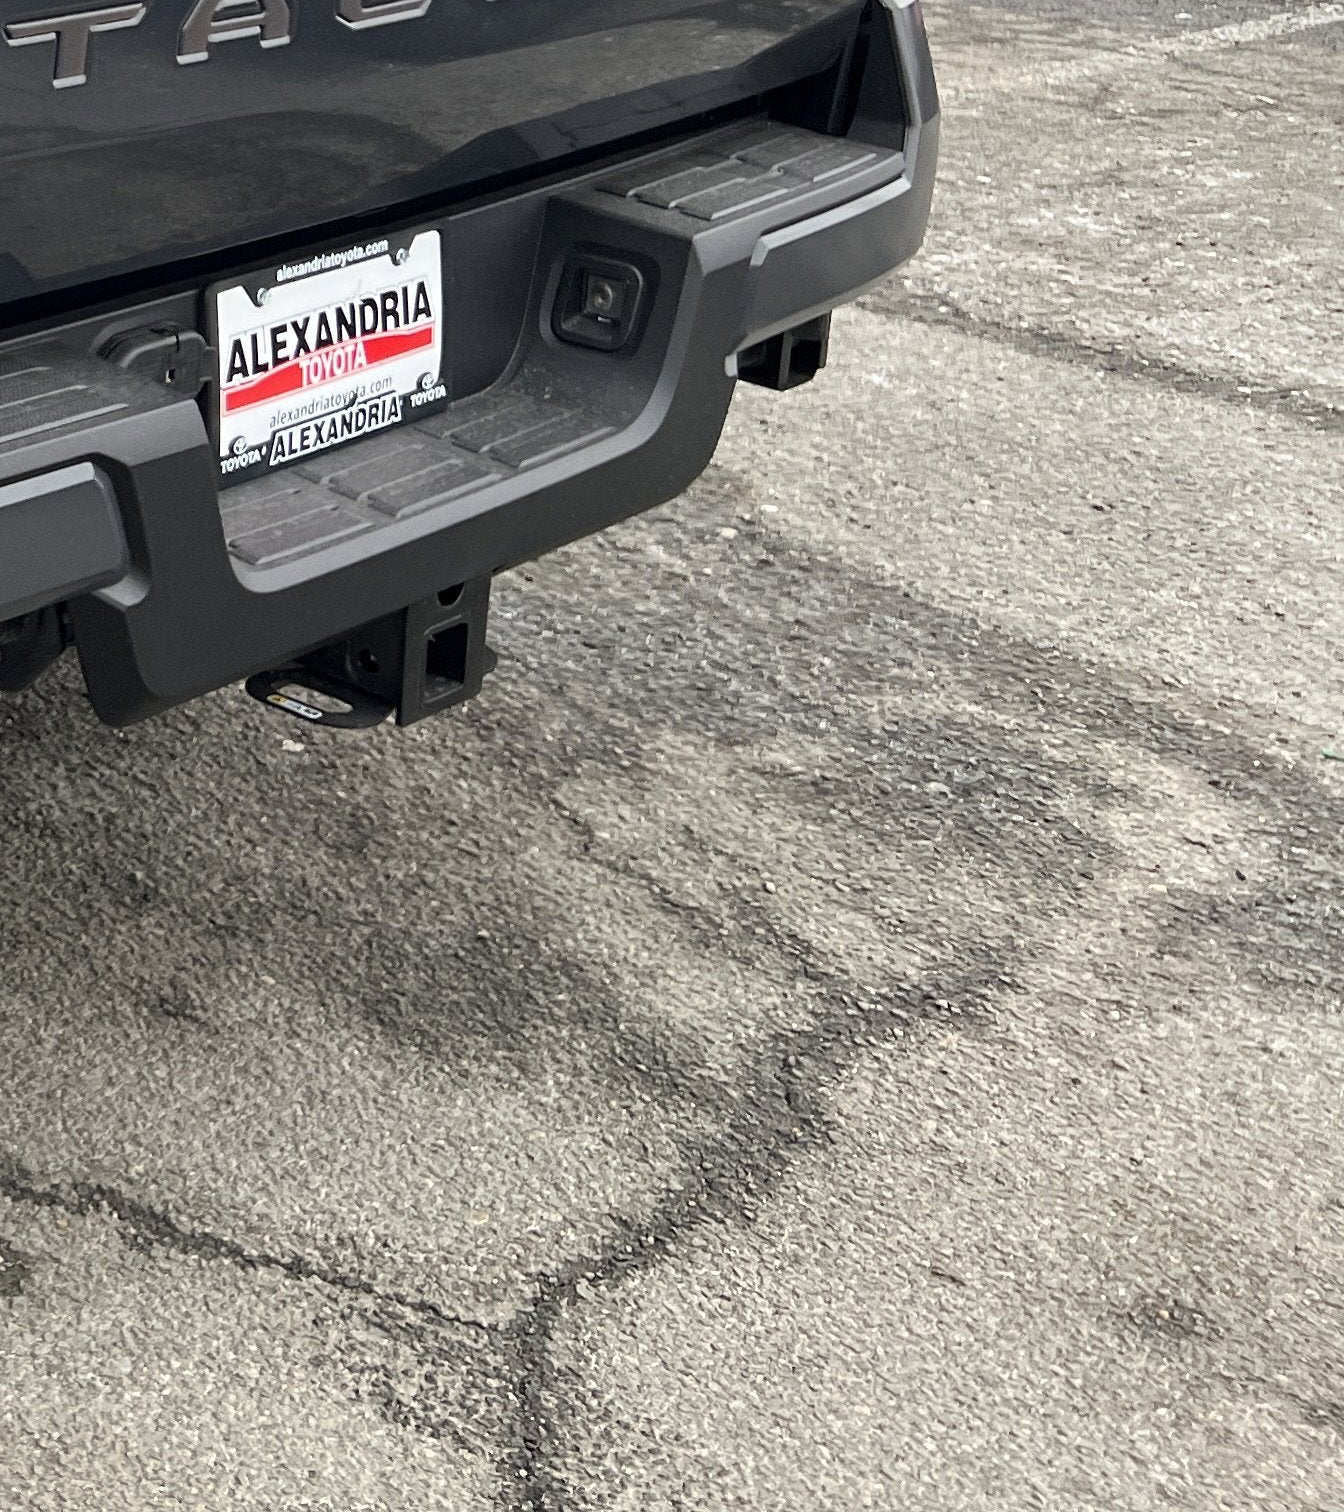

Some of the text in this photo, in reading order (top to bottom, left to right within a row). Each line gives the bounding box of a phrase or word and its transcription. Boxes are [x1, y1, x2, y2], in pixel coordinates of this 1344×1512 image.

[275, 239, 389, 282] alexandriatoyota.com
[225, 280, 433, 384] ALEXANDRIA
[300, 341, 368, 384] TOYOTA
[269, 376, 393, 429] alexandriatoyota.com
[220, 384, 447, 475] TOYOTA ALEXANDRIA TOYOTA
